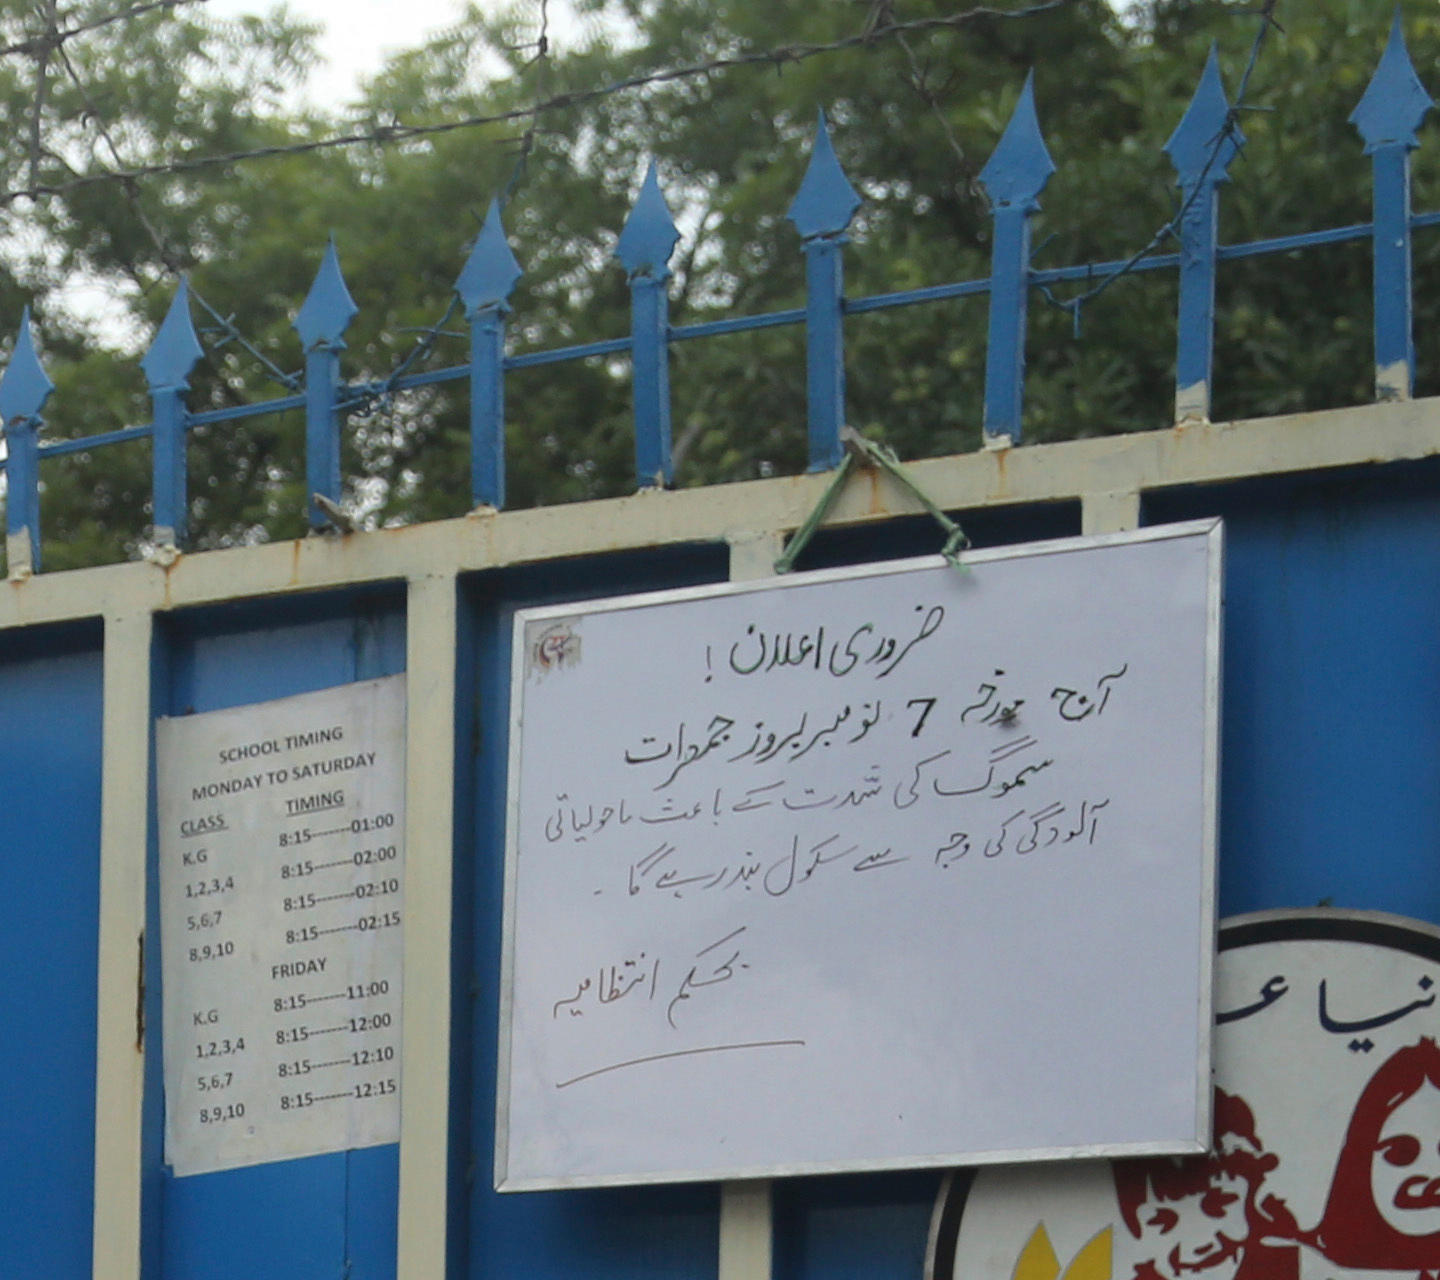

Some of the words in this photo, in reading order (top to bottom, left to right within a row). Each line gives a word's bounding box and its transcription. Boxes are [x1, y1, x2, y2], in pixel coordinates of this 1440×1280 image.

[728, 625, 823, 676] اعلان
[829, 604, 945, 679] ضروری
[1050, 663, 1128, 721] آج
[788, 700, 881, 763] نومبر
[907, 697, 937, 738] 7
[219, 740, 281, 765] SCHOOL
[285, 726, 344, 751] TIMING
[192, 775, 262, 801] MONDAY
[268, 769, 289, 786] TO
[292, 752, 377, 781] SATURDAY
[780, 764, 885, 808] شدت
[893, 749, 951, 809] کی
[934, 735, 1055, 798] سموگ
[286, 790, 346, 815] TIMING
[638, 788, 723, 827] باعث
[731, 780, 786, 813] کے
[180, 814, 226, 836] CLASS
[983, 809, 1021, 859] کی
[1016, 799, 1110, 857] آلودگی
[182, 850, 208, 866] K.G
[763, 833, 859, 897] سکول
[934, 831, 972, 870] وجہ
[185, 876, 235, 899] 1,2,3,4
[187, 911, 222, 931] 5,6,7
[189, 941, 234, 962] 8,9,10
[271, 957, 328, 980] FRIDAY
[193, 1009, 219, 1026] K.G
[1319, 974, 1438, 1054] نیا
[196, 1037, 245, 1059] 1,2,3,4
[197, 1072, 233, 1092] 5,6,7
[199, 1103, 245, 1124] 8,9,10
